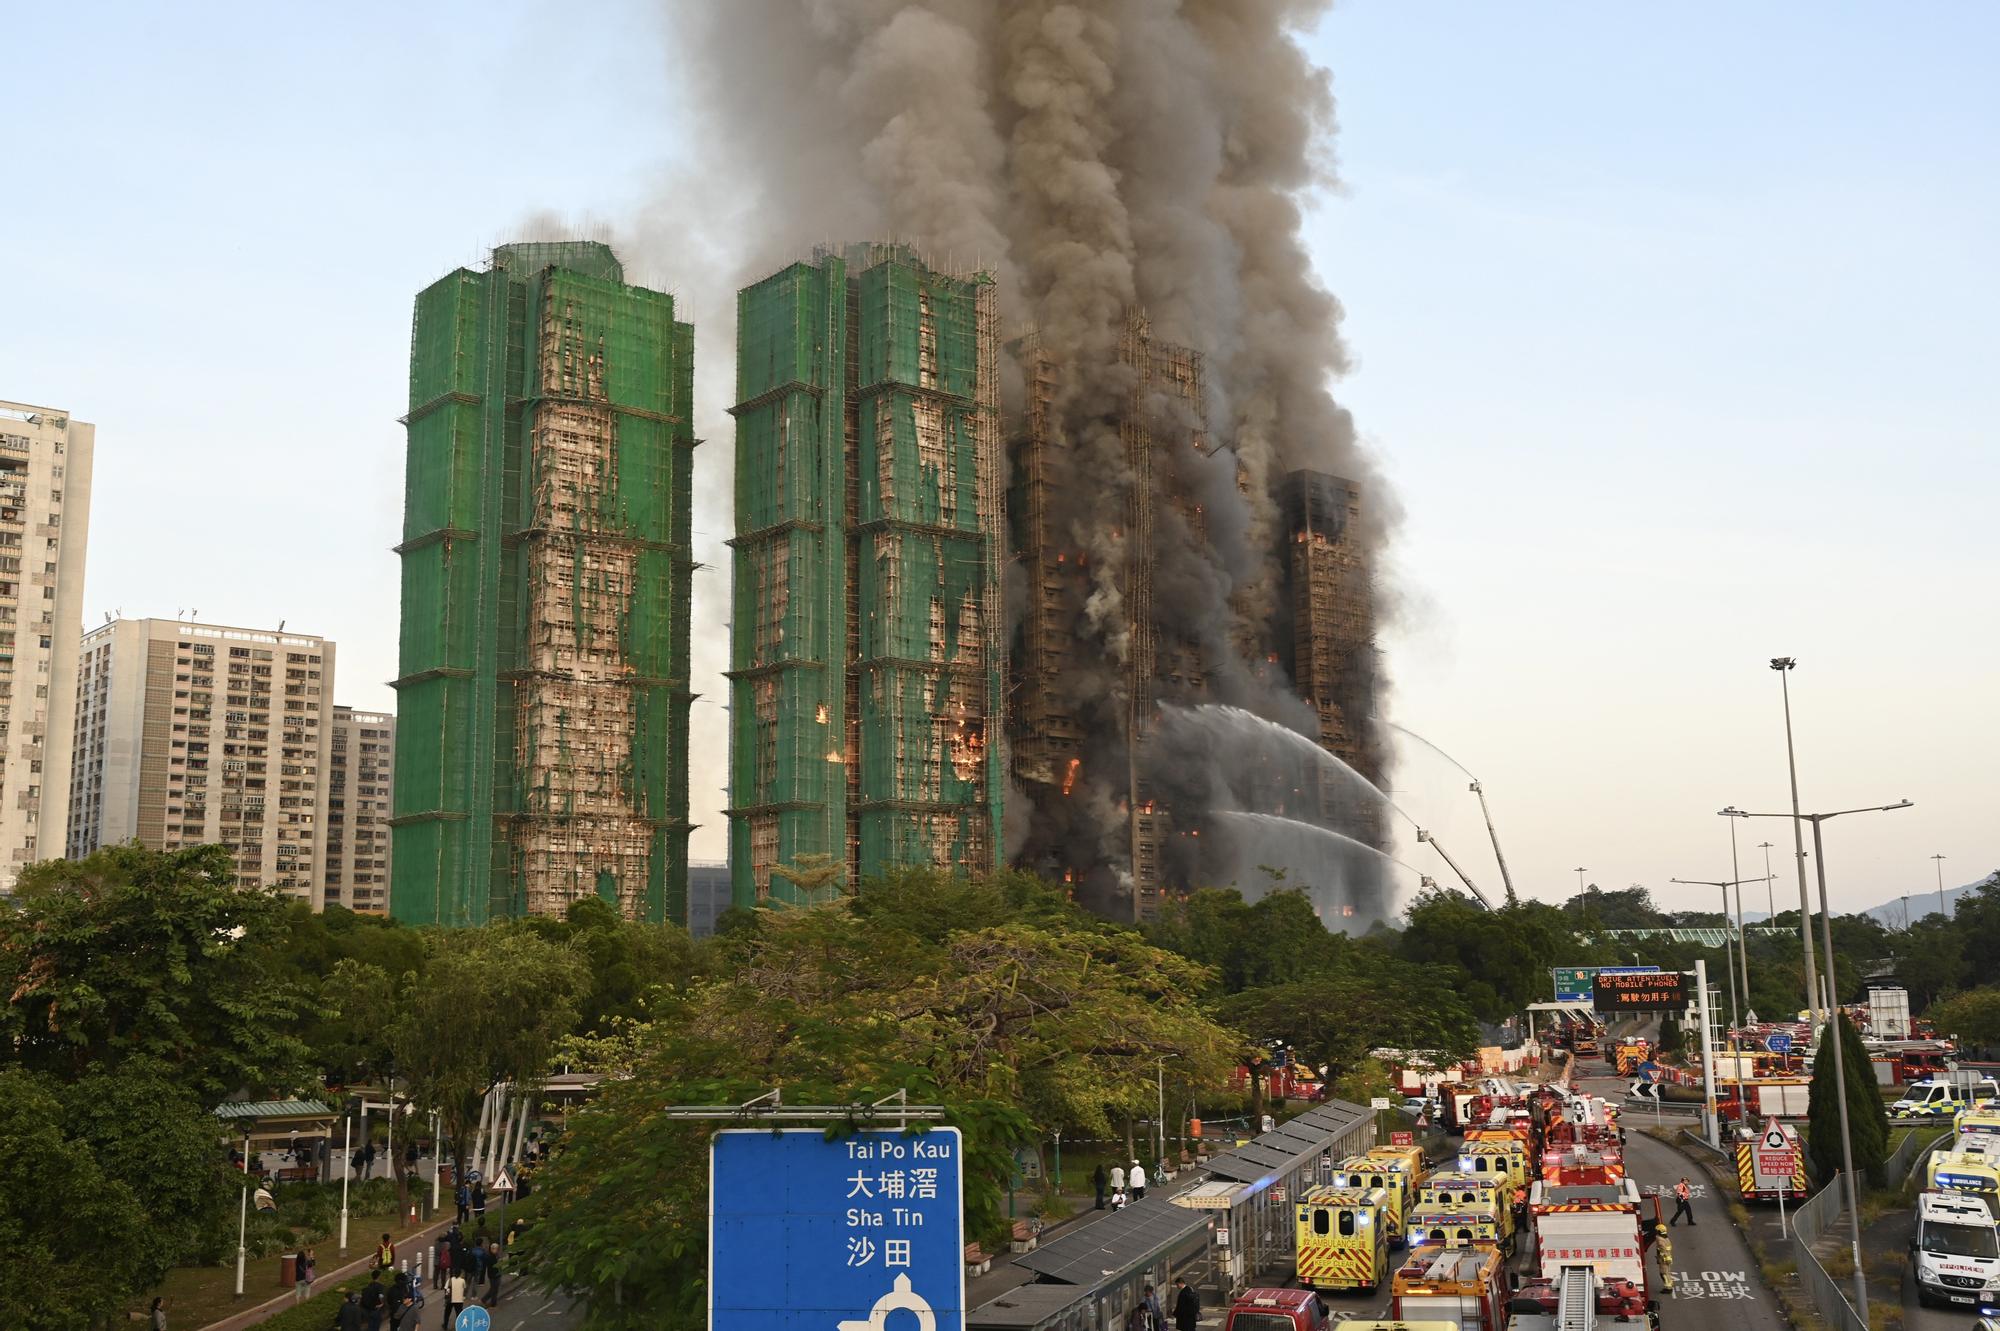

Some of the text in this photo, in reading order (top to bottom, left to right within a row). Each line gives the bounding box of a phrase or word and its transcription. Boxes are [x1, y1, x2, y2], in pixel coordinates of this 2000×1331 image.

[846, 1141, 950, 1159] Tai Po Kau
[846, 1168, 937, 1198] 大埔滘
[847, 1208, 923, 1226] Sha Tin
[847, 1236, 910, 1268] 沙田
[1670, 1271, 1745, 1281] SLOW
